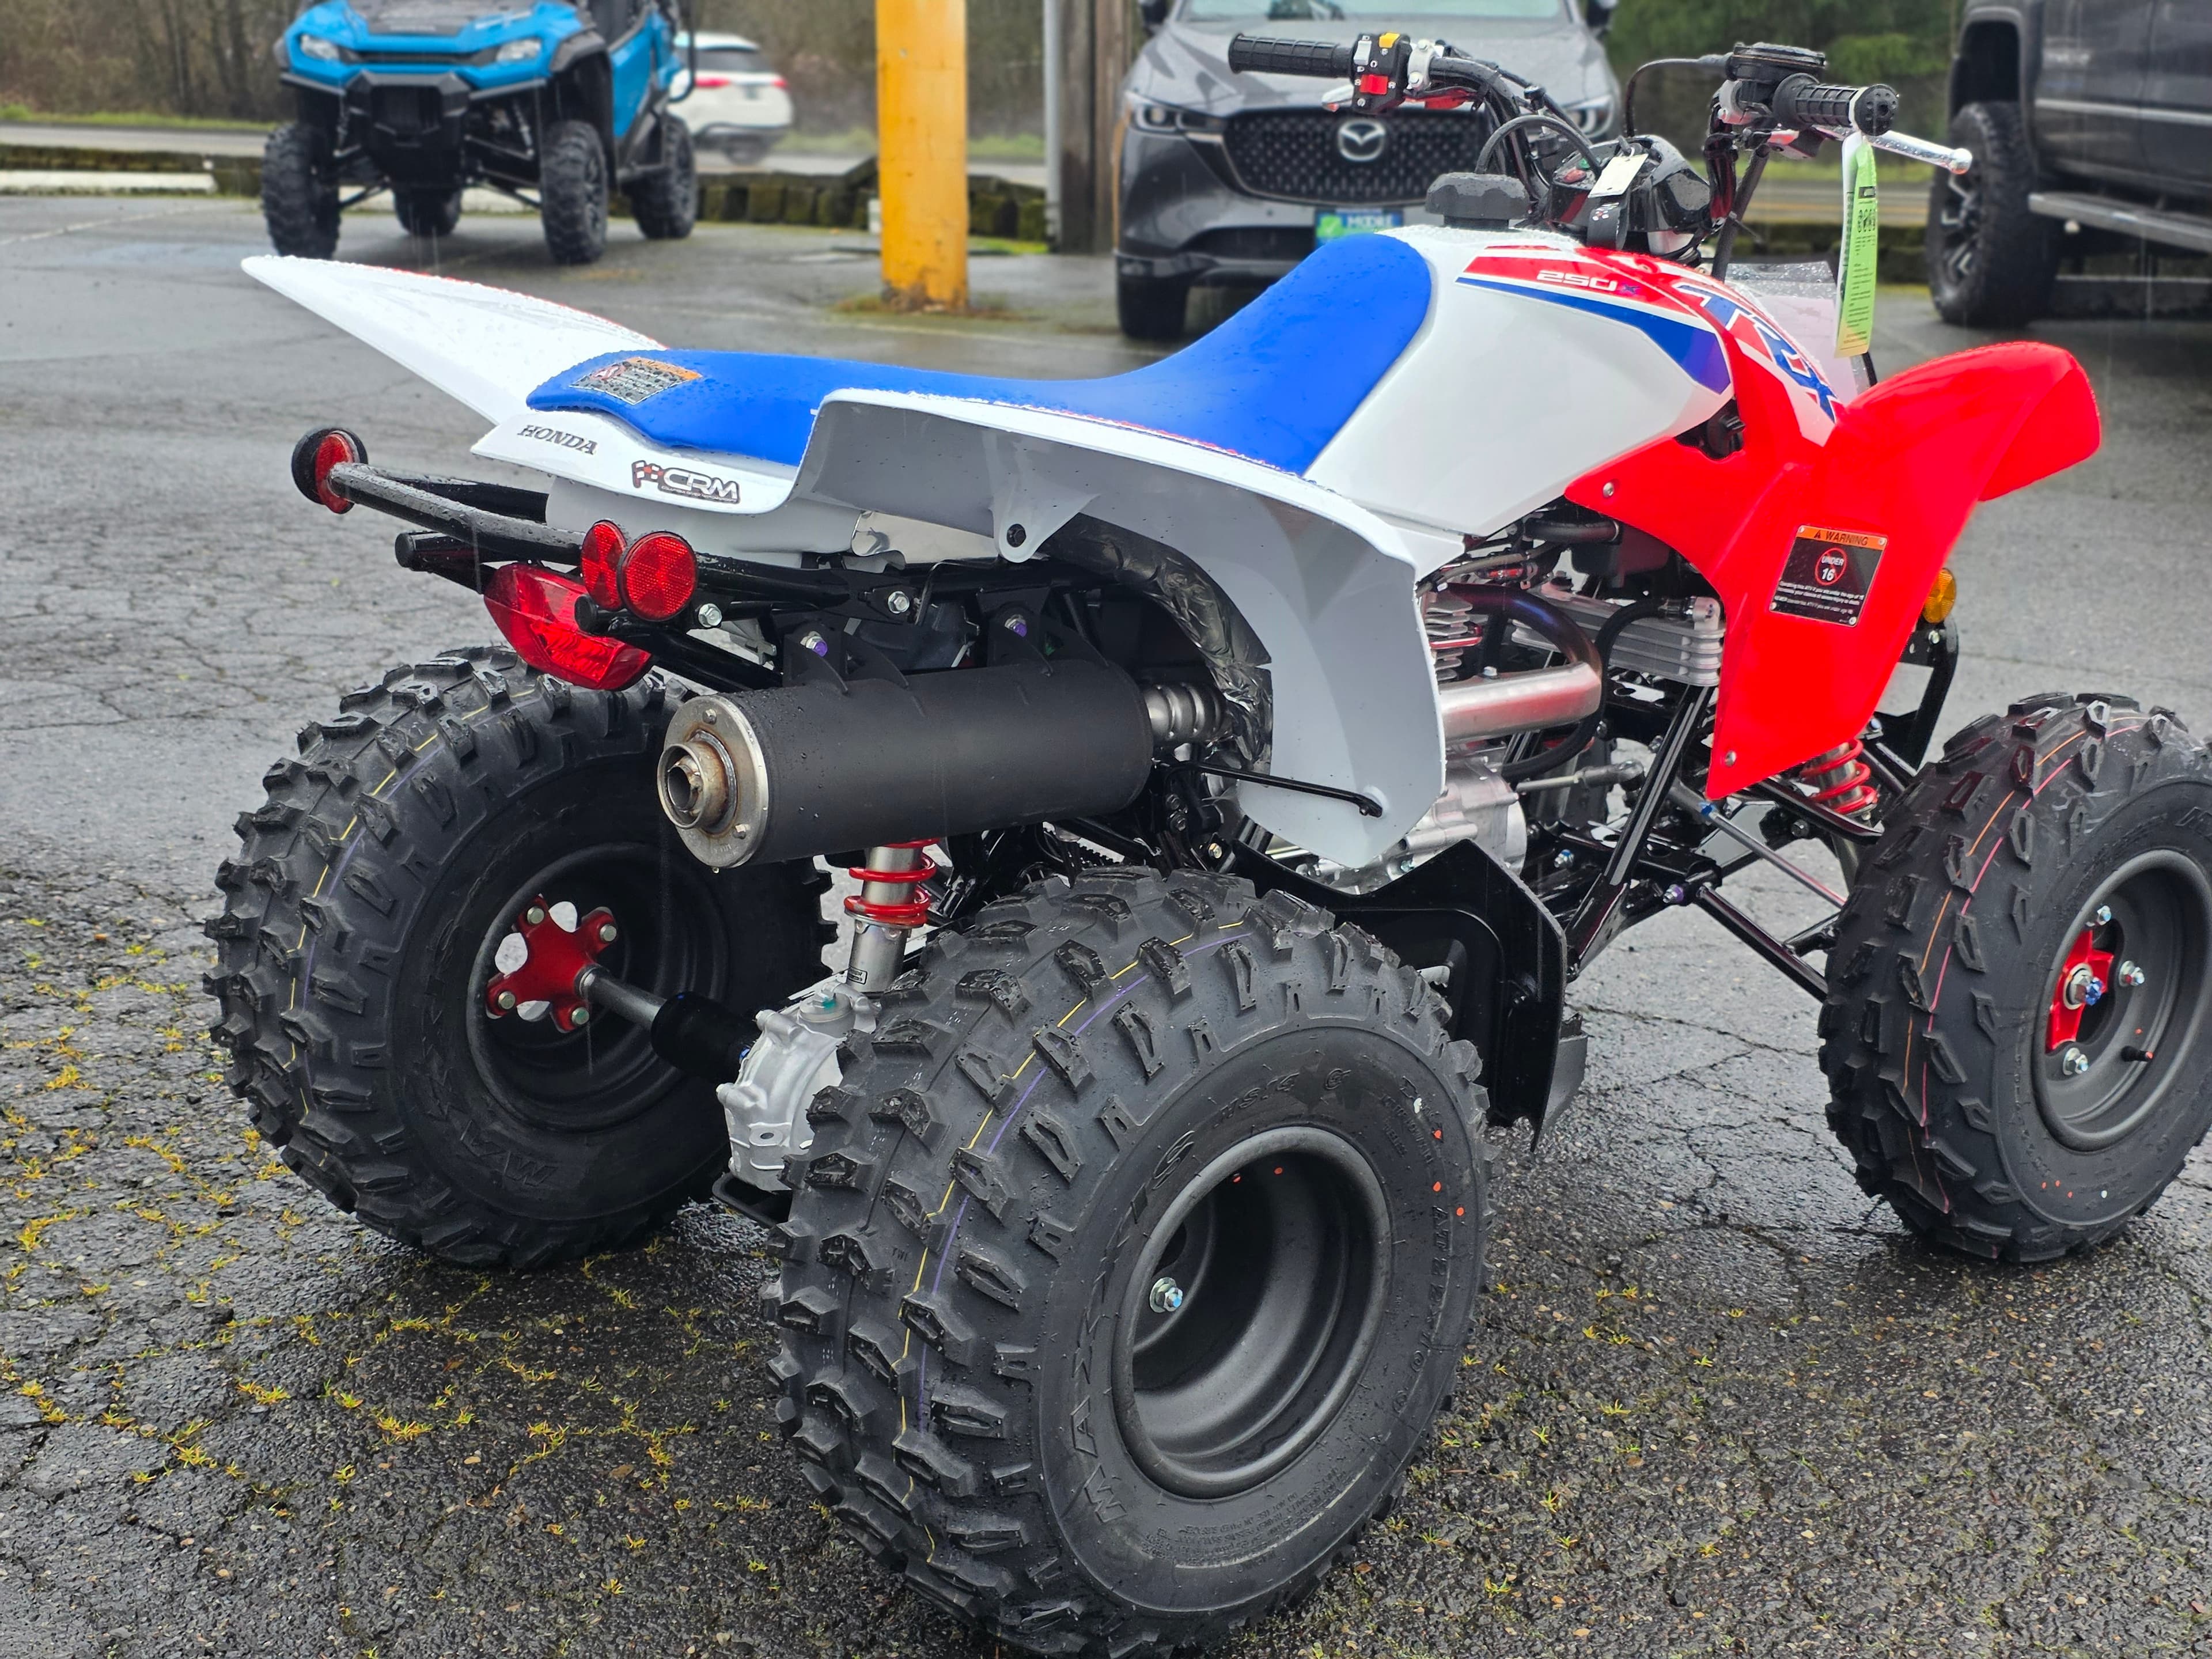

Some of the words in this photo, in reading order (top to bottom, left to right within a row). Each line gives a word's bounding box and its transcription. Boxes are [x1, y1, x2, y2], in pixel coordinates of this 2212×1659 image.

[1672, 282, 1837, 424] TRX
[517, 425, 598, 455] HONDA
[664, 469, 738, 499] CRM
[1825, 531, 1869, 546] WARNING
[1821, 555, 1844, 566] UNDER
[1821, 567, 1835, 581] 16
